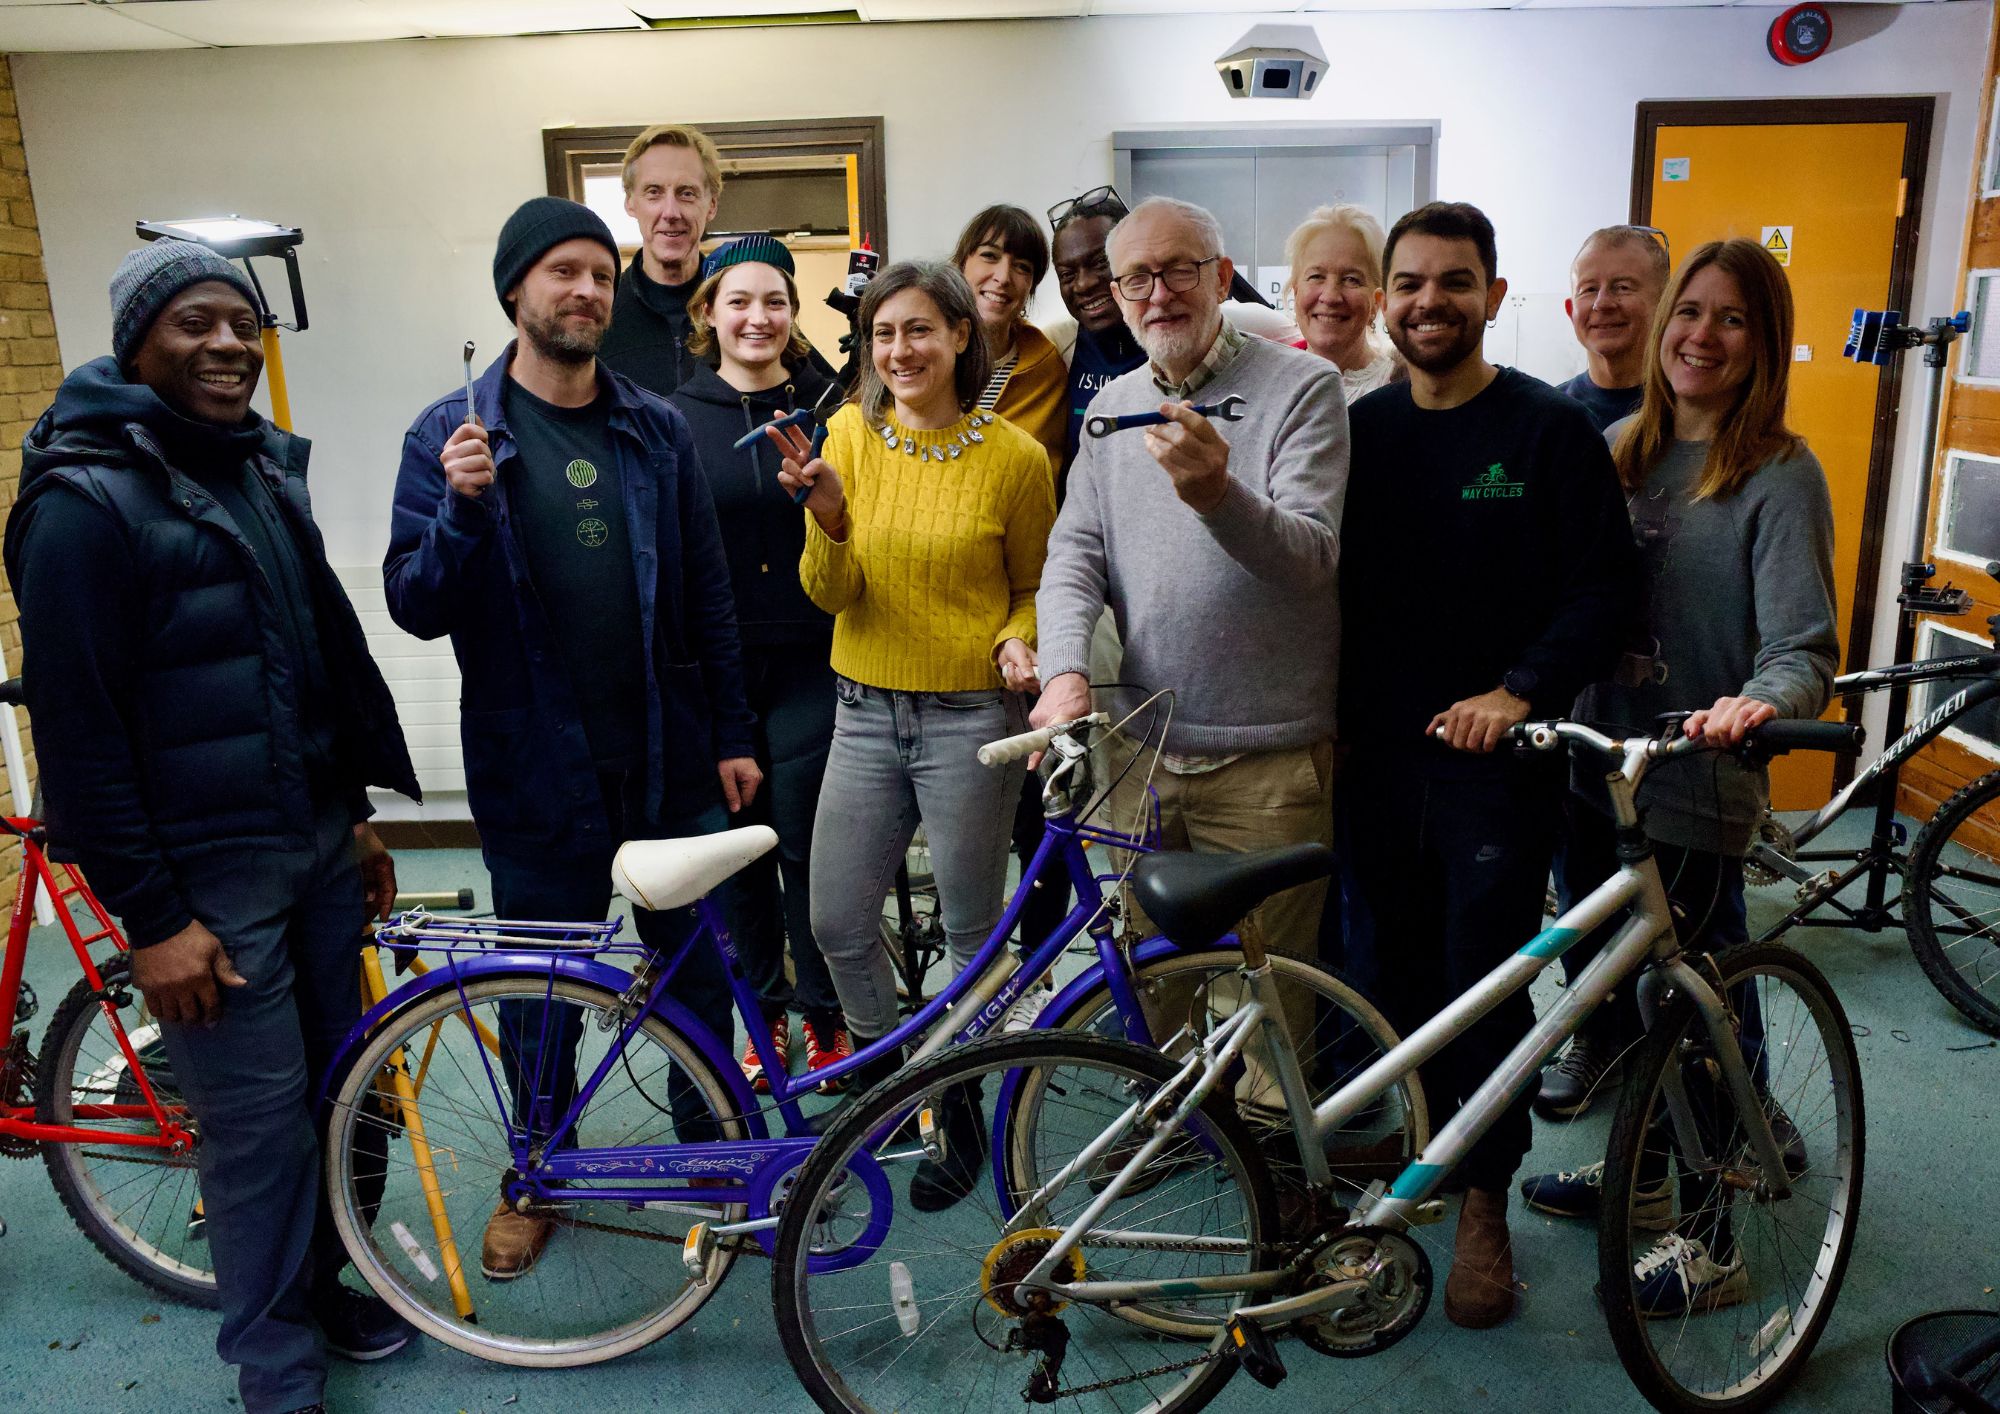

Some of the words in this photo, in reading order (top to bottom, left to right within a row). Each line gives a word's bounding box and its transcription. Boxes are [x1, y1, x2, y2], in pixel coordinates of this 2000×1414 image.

[1805, 11, 1825, 25] ALARM
[1462, 488, 1481, 499] WAY
[1483, 487, 1523, 498] CYCLES
[1911, 657, 1980, 672] HARDROCK
[1872, 689, 1967, 777] SPECIALIZED
[954, 986, 1016, 1043] EIGH
